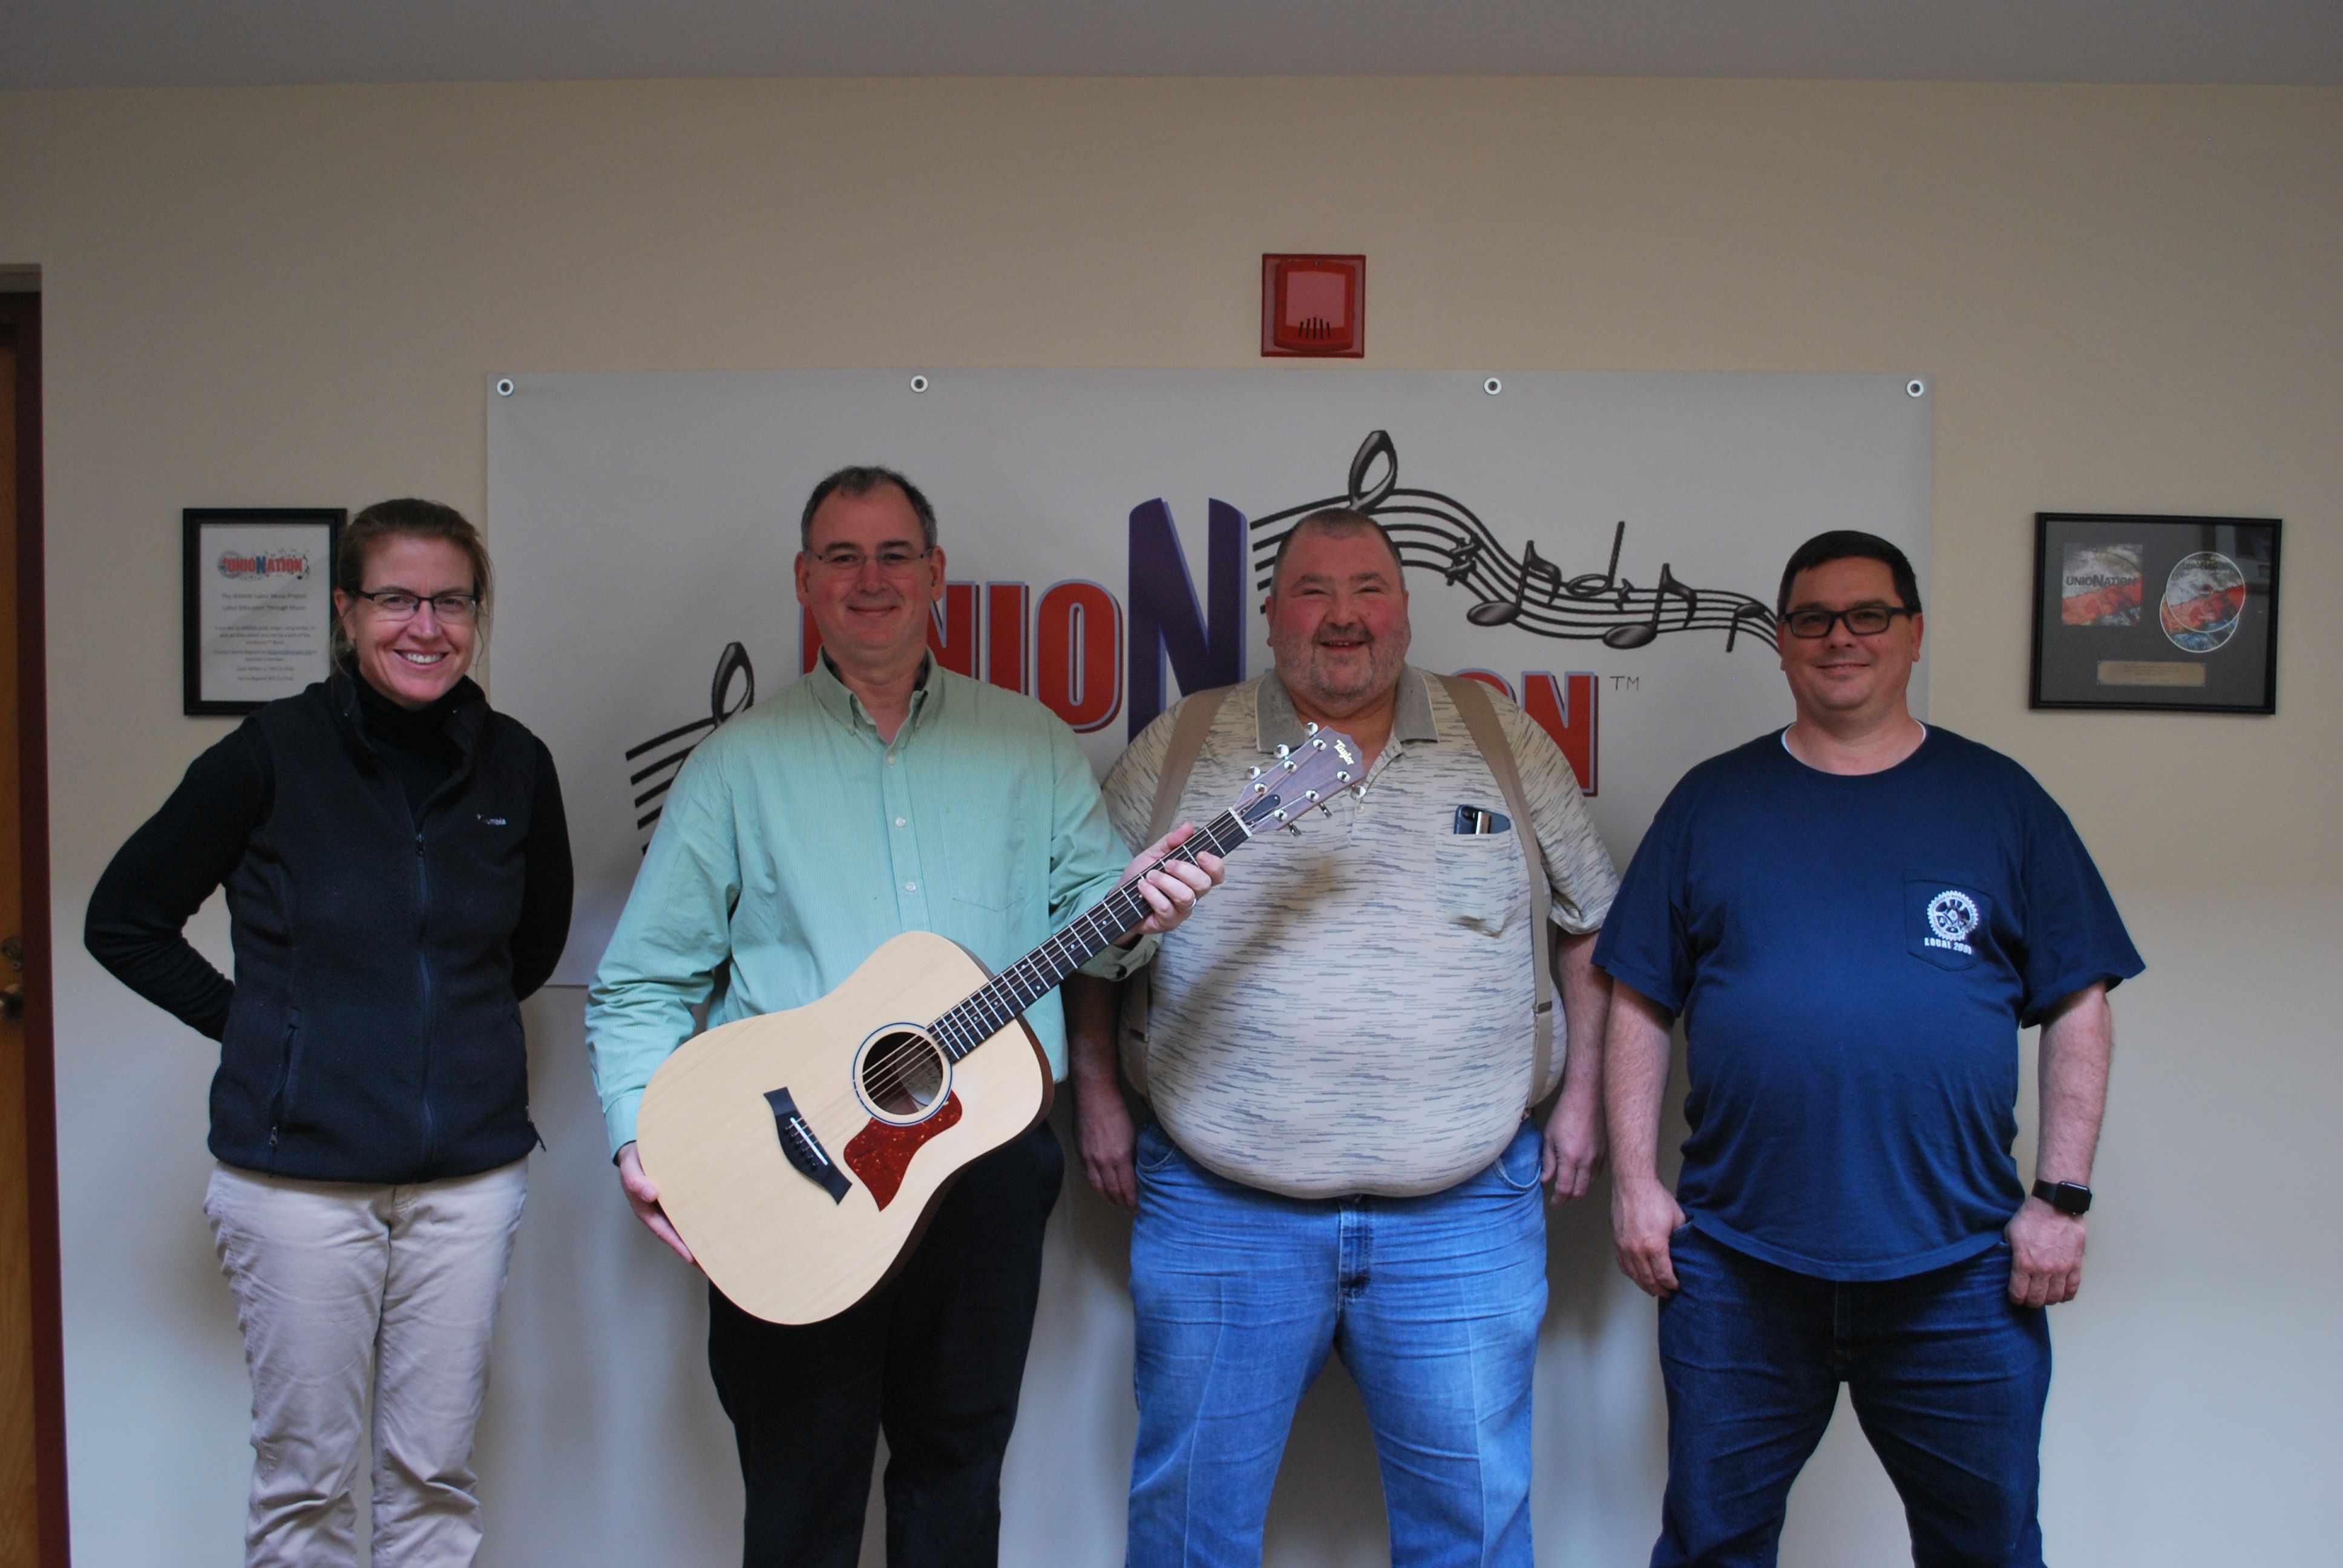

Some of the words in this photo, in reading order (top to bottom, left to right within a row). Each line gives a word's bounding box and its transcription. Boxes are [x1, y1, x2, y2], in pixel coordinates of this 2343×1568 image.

[1610, 675, 1640, 691] TM
[1334, 739, 1354, 765] Taylor
[1924, 938, 1951, 949] LOCAL
